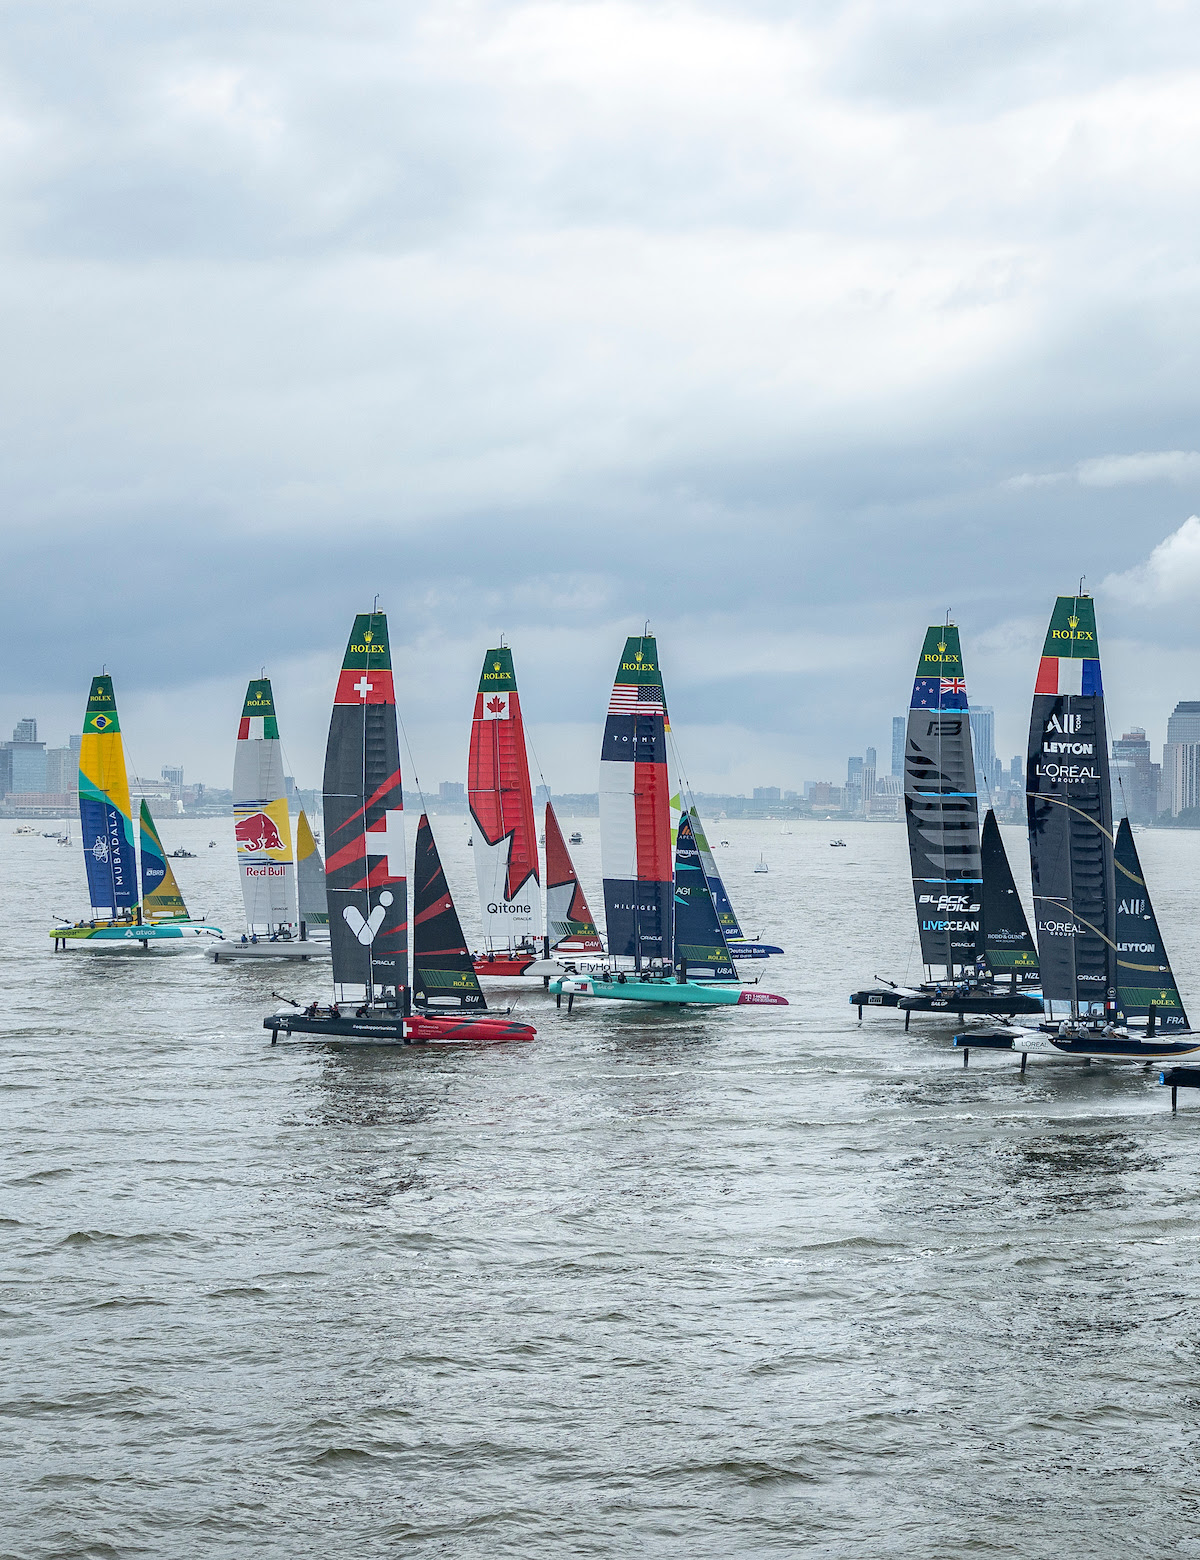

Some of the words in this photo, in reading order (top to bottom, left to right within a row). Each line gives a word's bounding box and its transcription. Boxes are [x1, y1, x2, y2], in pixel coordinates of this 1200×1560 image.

[1052, 630, 1093, 640] ROLEX
[924, 654, 959, 662] ROLEX
[1044, 742, 1092, 754] LEYTON
[1036, 764, 1100, 778] L'ORÉAL
[109, 811, 123, 885] MUBADALA
[246, 867, 266, 876] Red
[268, 866, 285, 876] Bull
[676, 887, 690, 895] AG1
[919, 895, 970, 904] BLACK
[487, 902, 531, 913] Qitone
[937, 904, 981, 912] FOILS
[1117, 943, 1155, 952] LEYTON
